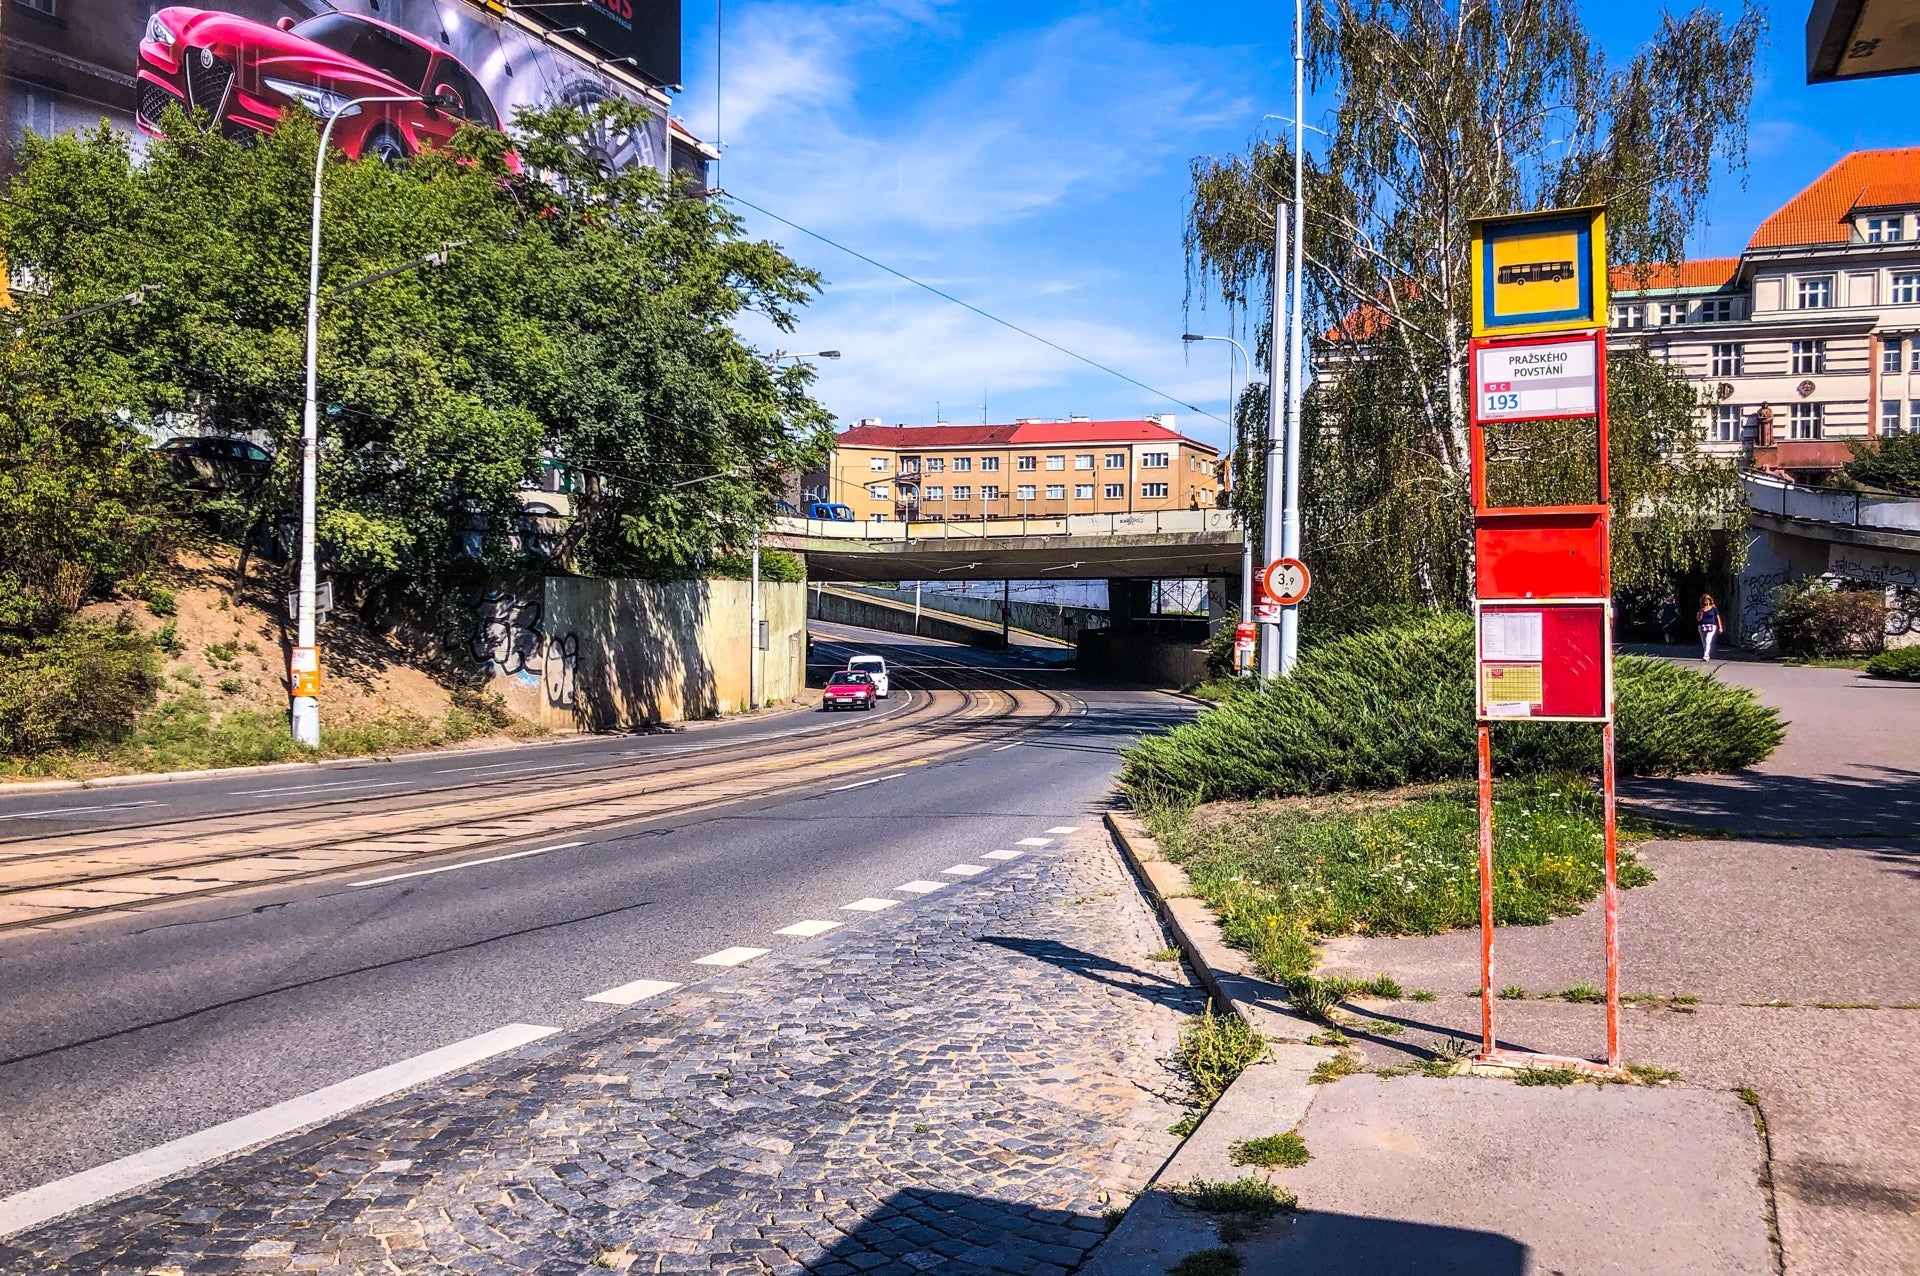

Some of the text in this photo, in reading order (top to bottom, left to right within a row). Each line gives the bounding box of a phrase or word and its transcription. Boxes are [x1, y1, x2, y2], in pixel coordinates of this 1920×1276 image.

[1509, 352, 1568, 365] PRAŽSKÉHO
[1514, 364, 1563, 377] POVSTÁNÍ
[1500, 383, 1506, 391] C
[1487, 394, 1518, 410] 193
[1278, 573, 1295, 586] 3,9
